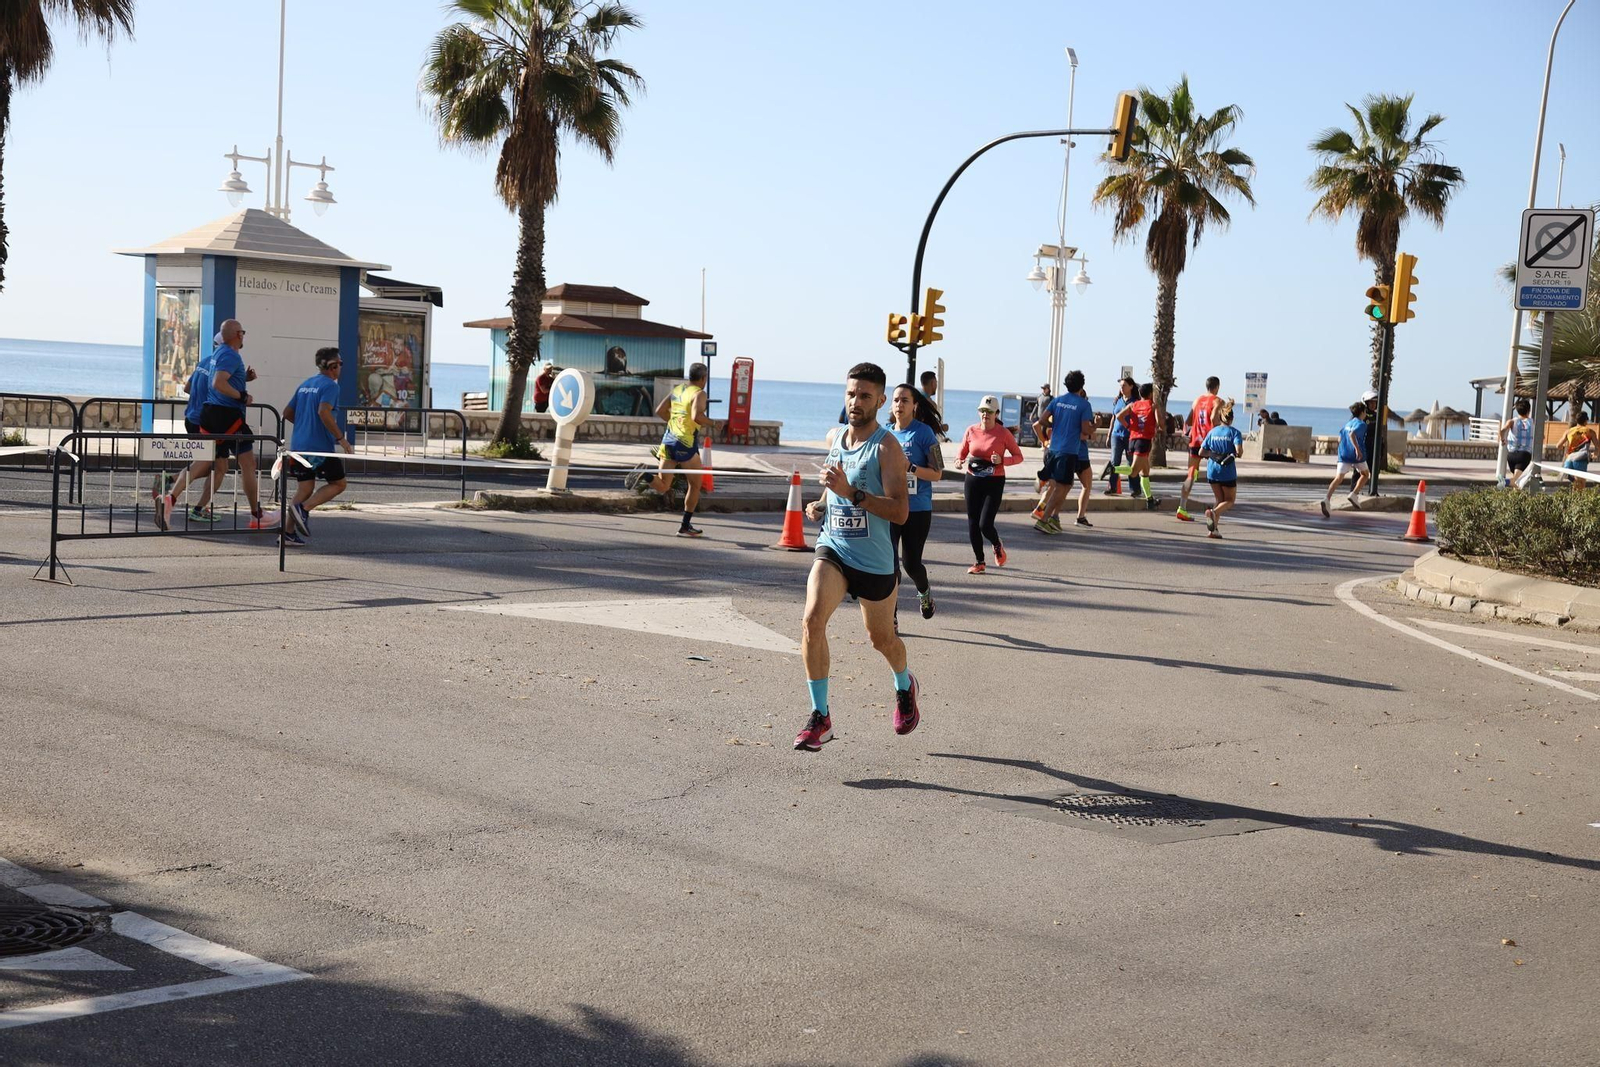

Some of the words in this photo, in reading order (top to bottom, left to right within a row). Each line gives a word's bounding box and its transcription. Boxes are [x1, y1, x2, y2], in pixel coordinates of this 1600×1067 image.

[239, 276, 277, 290] Helados
[286, 280, 301, 292] Ice
[302, 281, 338, 295] Creams
[397, 390, 408, 400] 10
[151, 441, 180, 450] POLA
[181, 441, 205, 450] LOCAL
[163, 451, 193, 459] MALAGA
[833, 517, 862, 528] 1647
